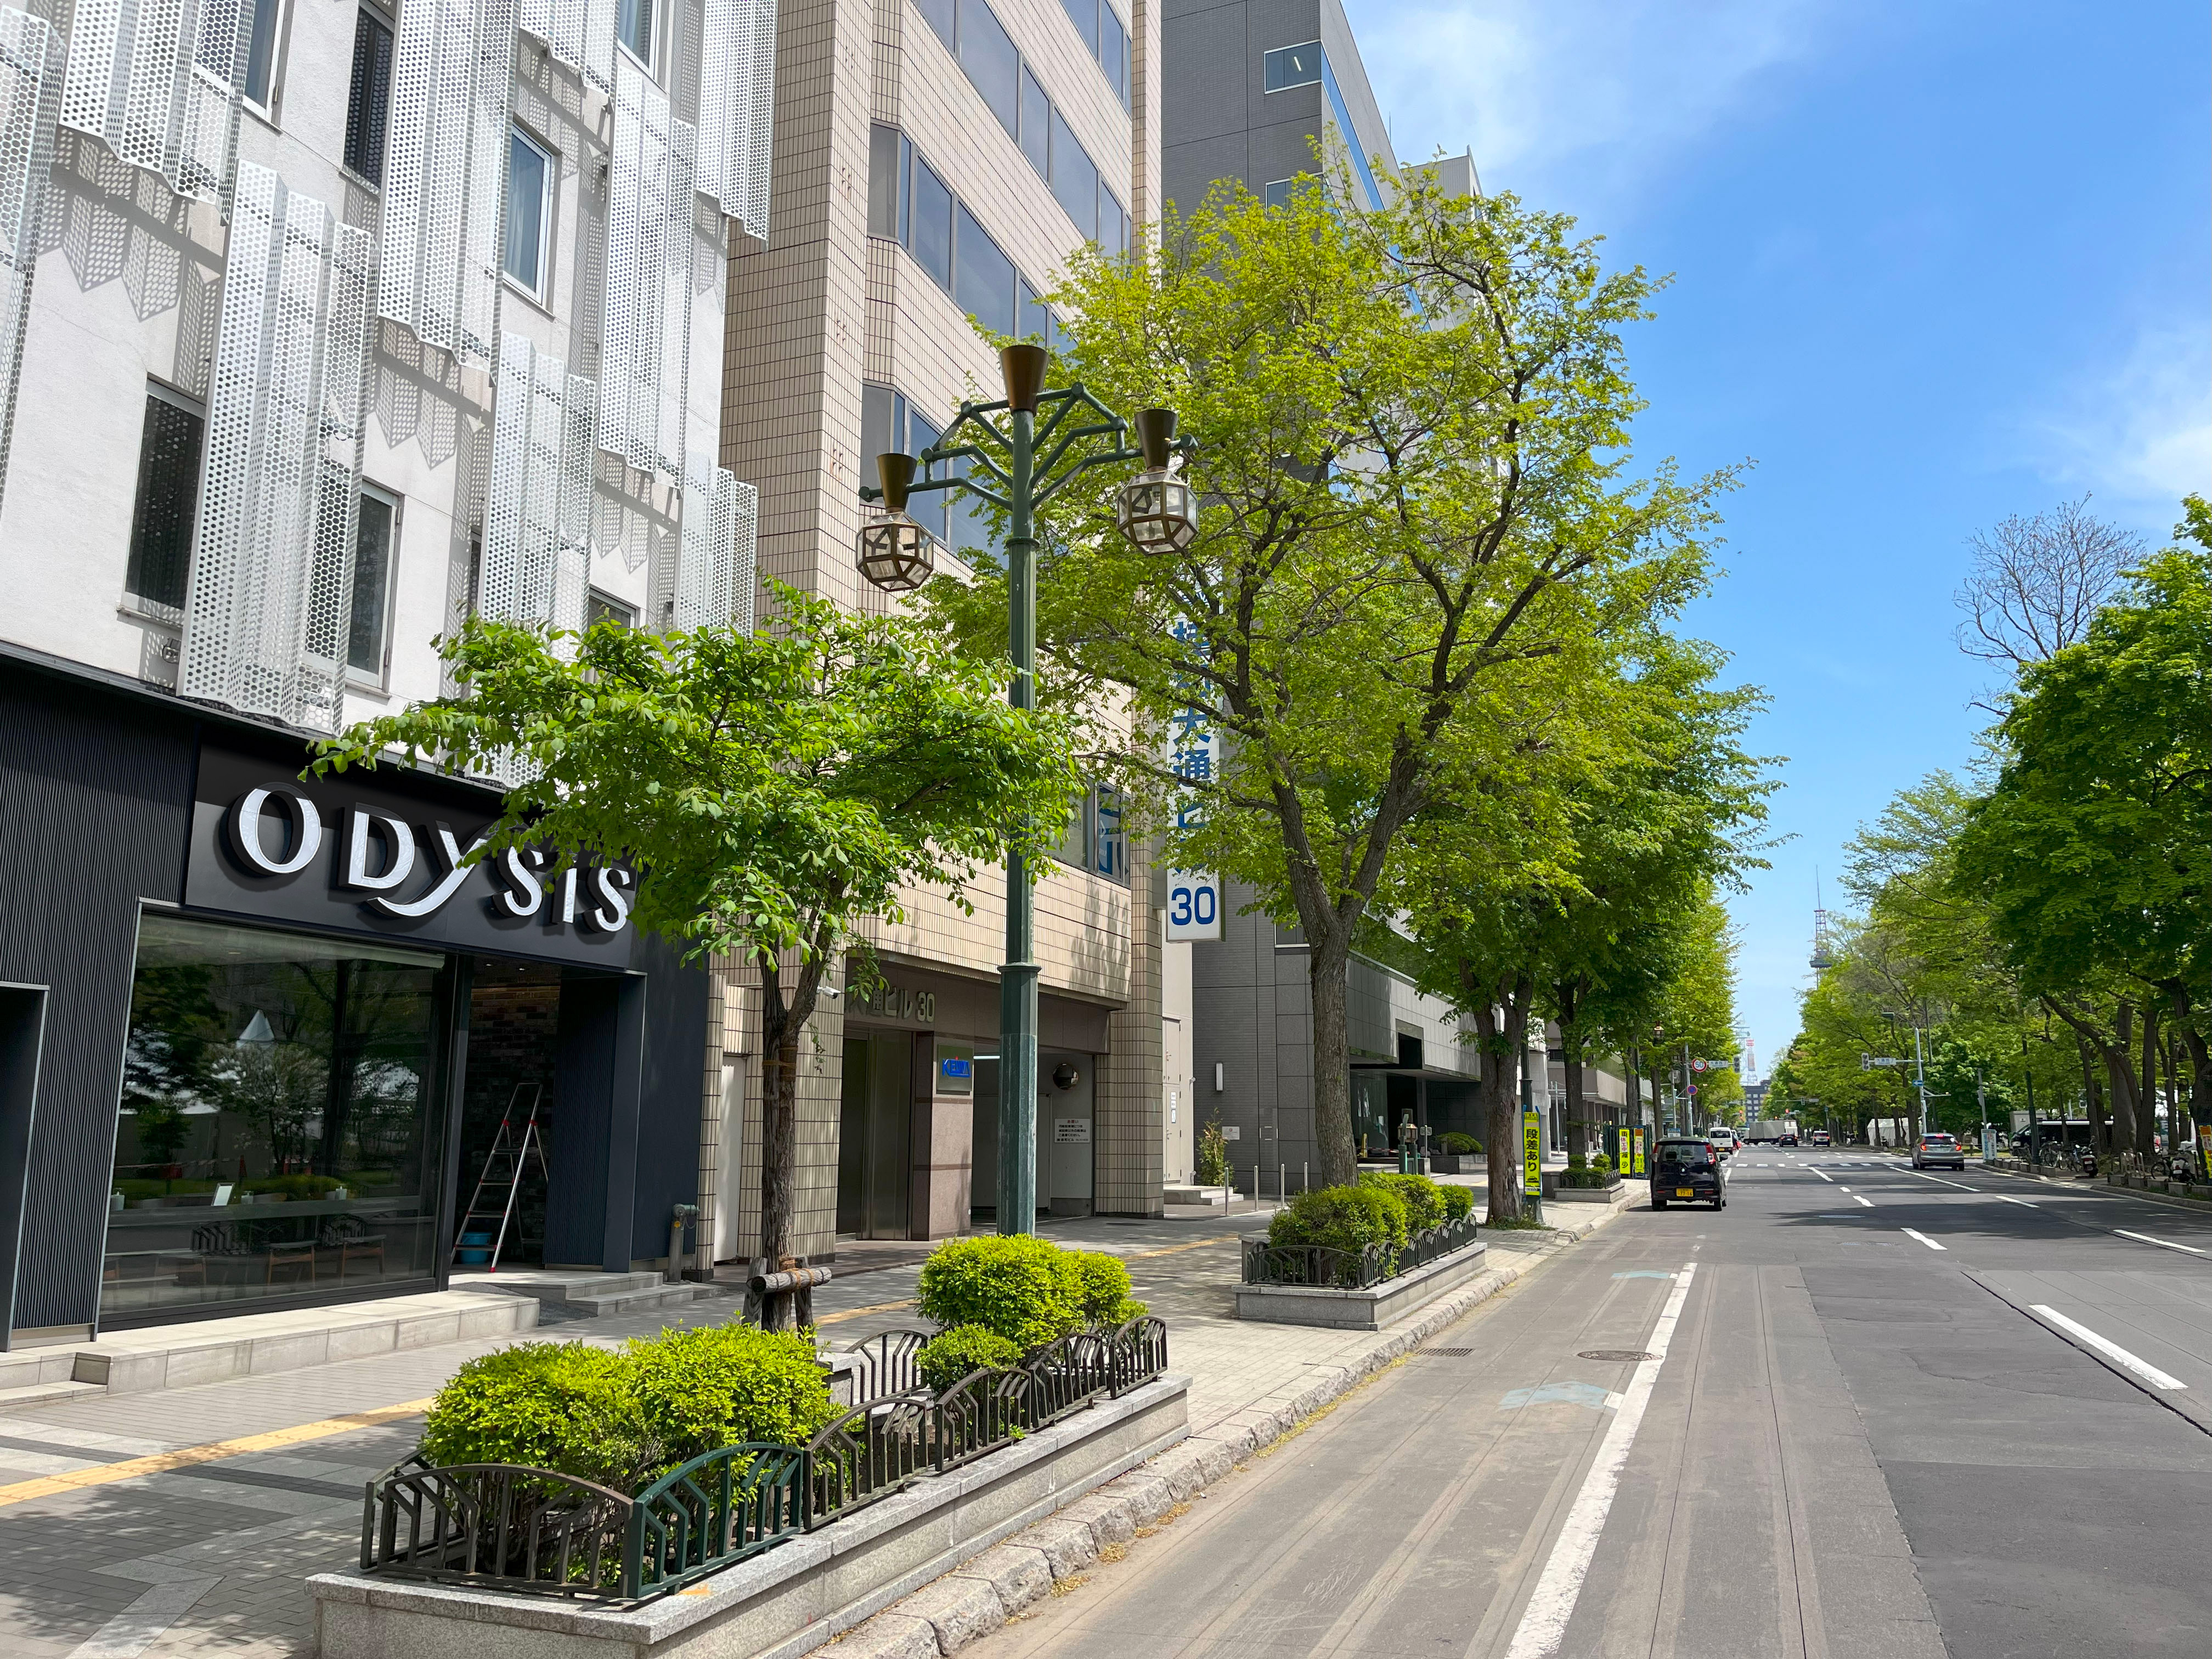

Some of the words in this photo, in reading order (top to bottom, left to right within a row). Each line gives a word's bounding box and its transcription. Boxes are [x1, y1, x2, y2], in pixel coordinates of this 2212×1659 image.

[1170, 886, 1216, 926] 30
[917, 991, 935, 1023] 30
[1526, 1129, 1538, 1171] 段差あり
